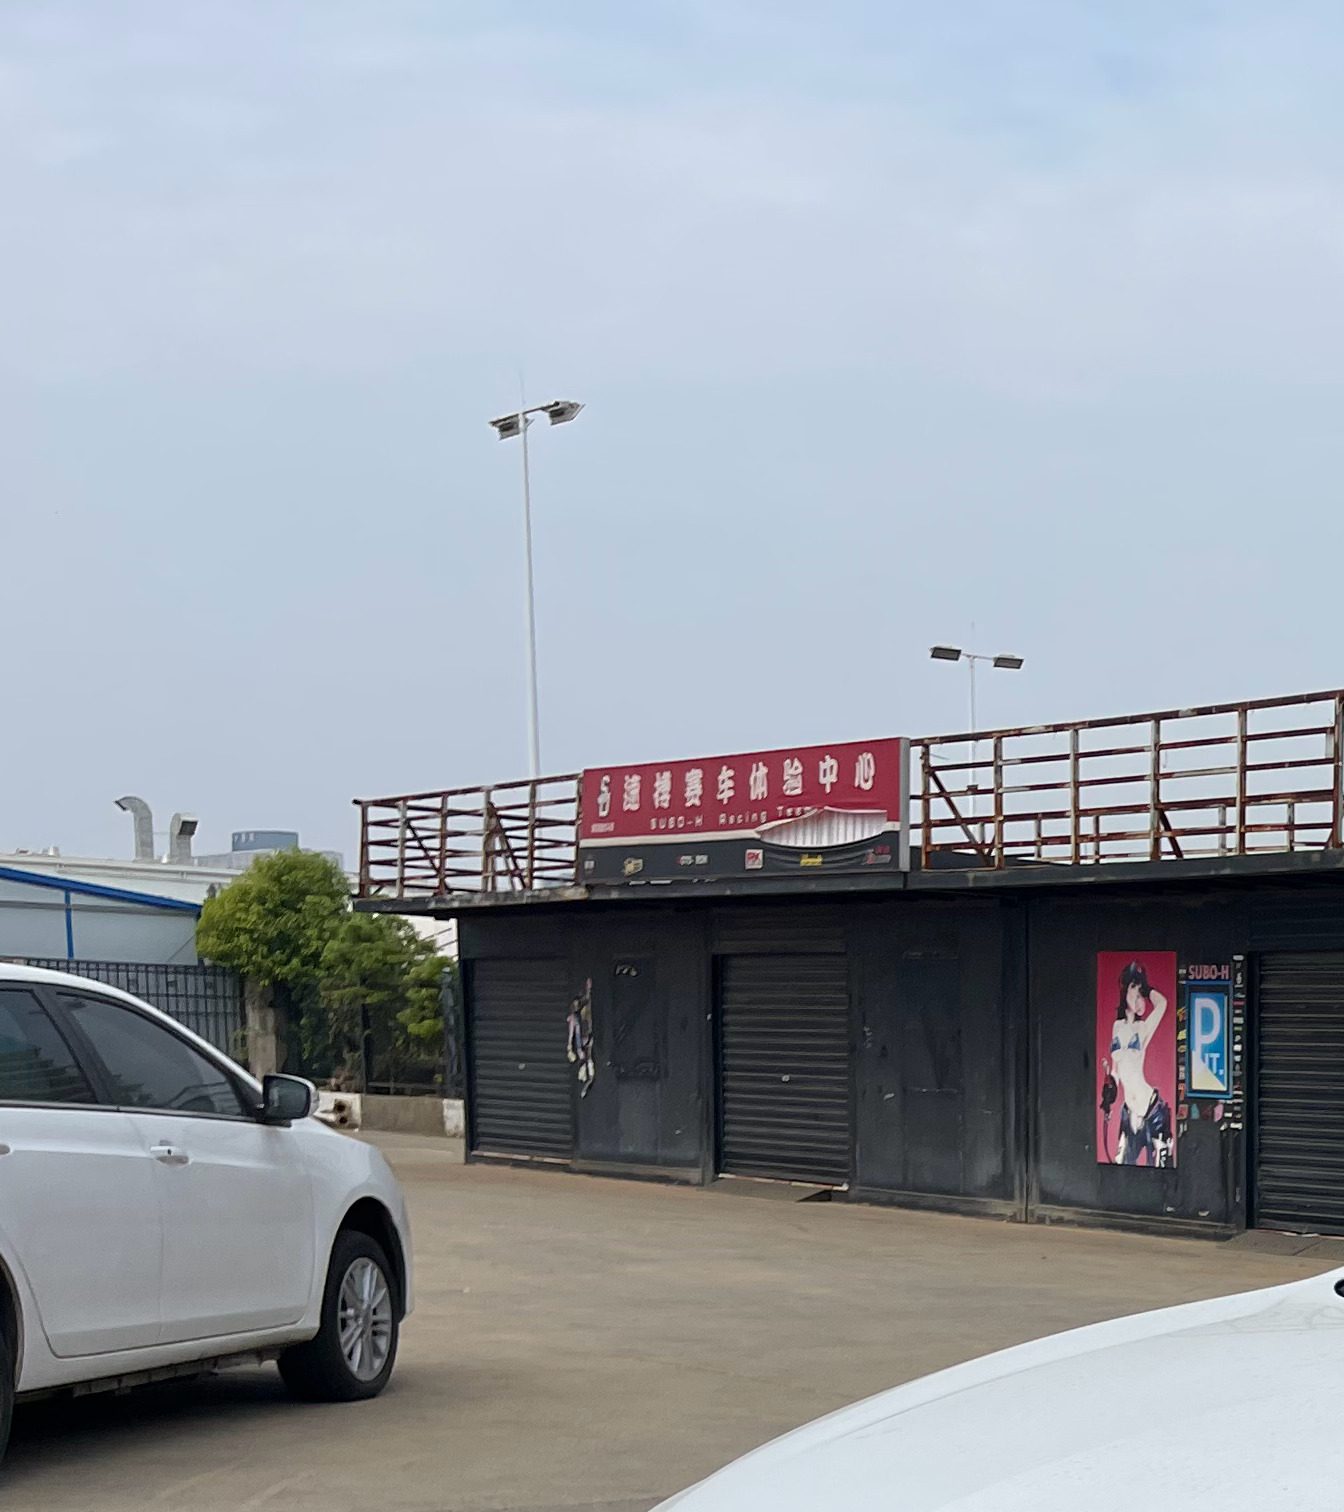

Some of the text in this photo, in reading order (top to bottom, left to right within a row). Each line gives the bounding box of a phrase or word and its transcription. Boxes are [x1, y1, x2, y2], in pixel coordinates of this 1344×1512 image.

[650, 815, 703, 830] SUBO-H
[719, 810, 768, 825] Racing
[1188, 965, 1230, 980] SUBO-H
